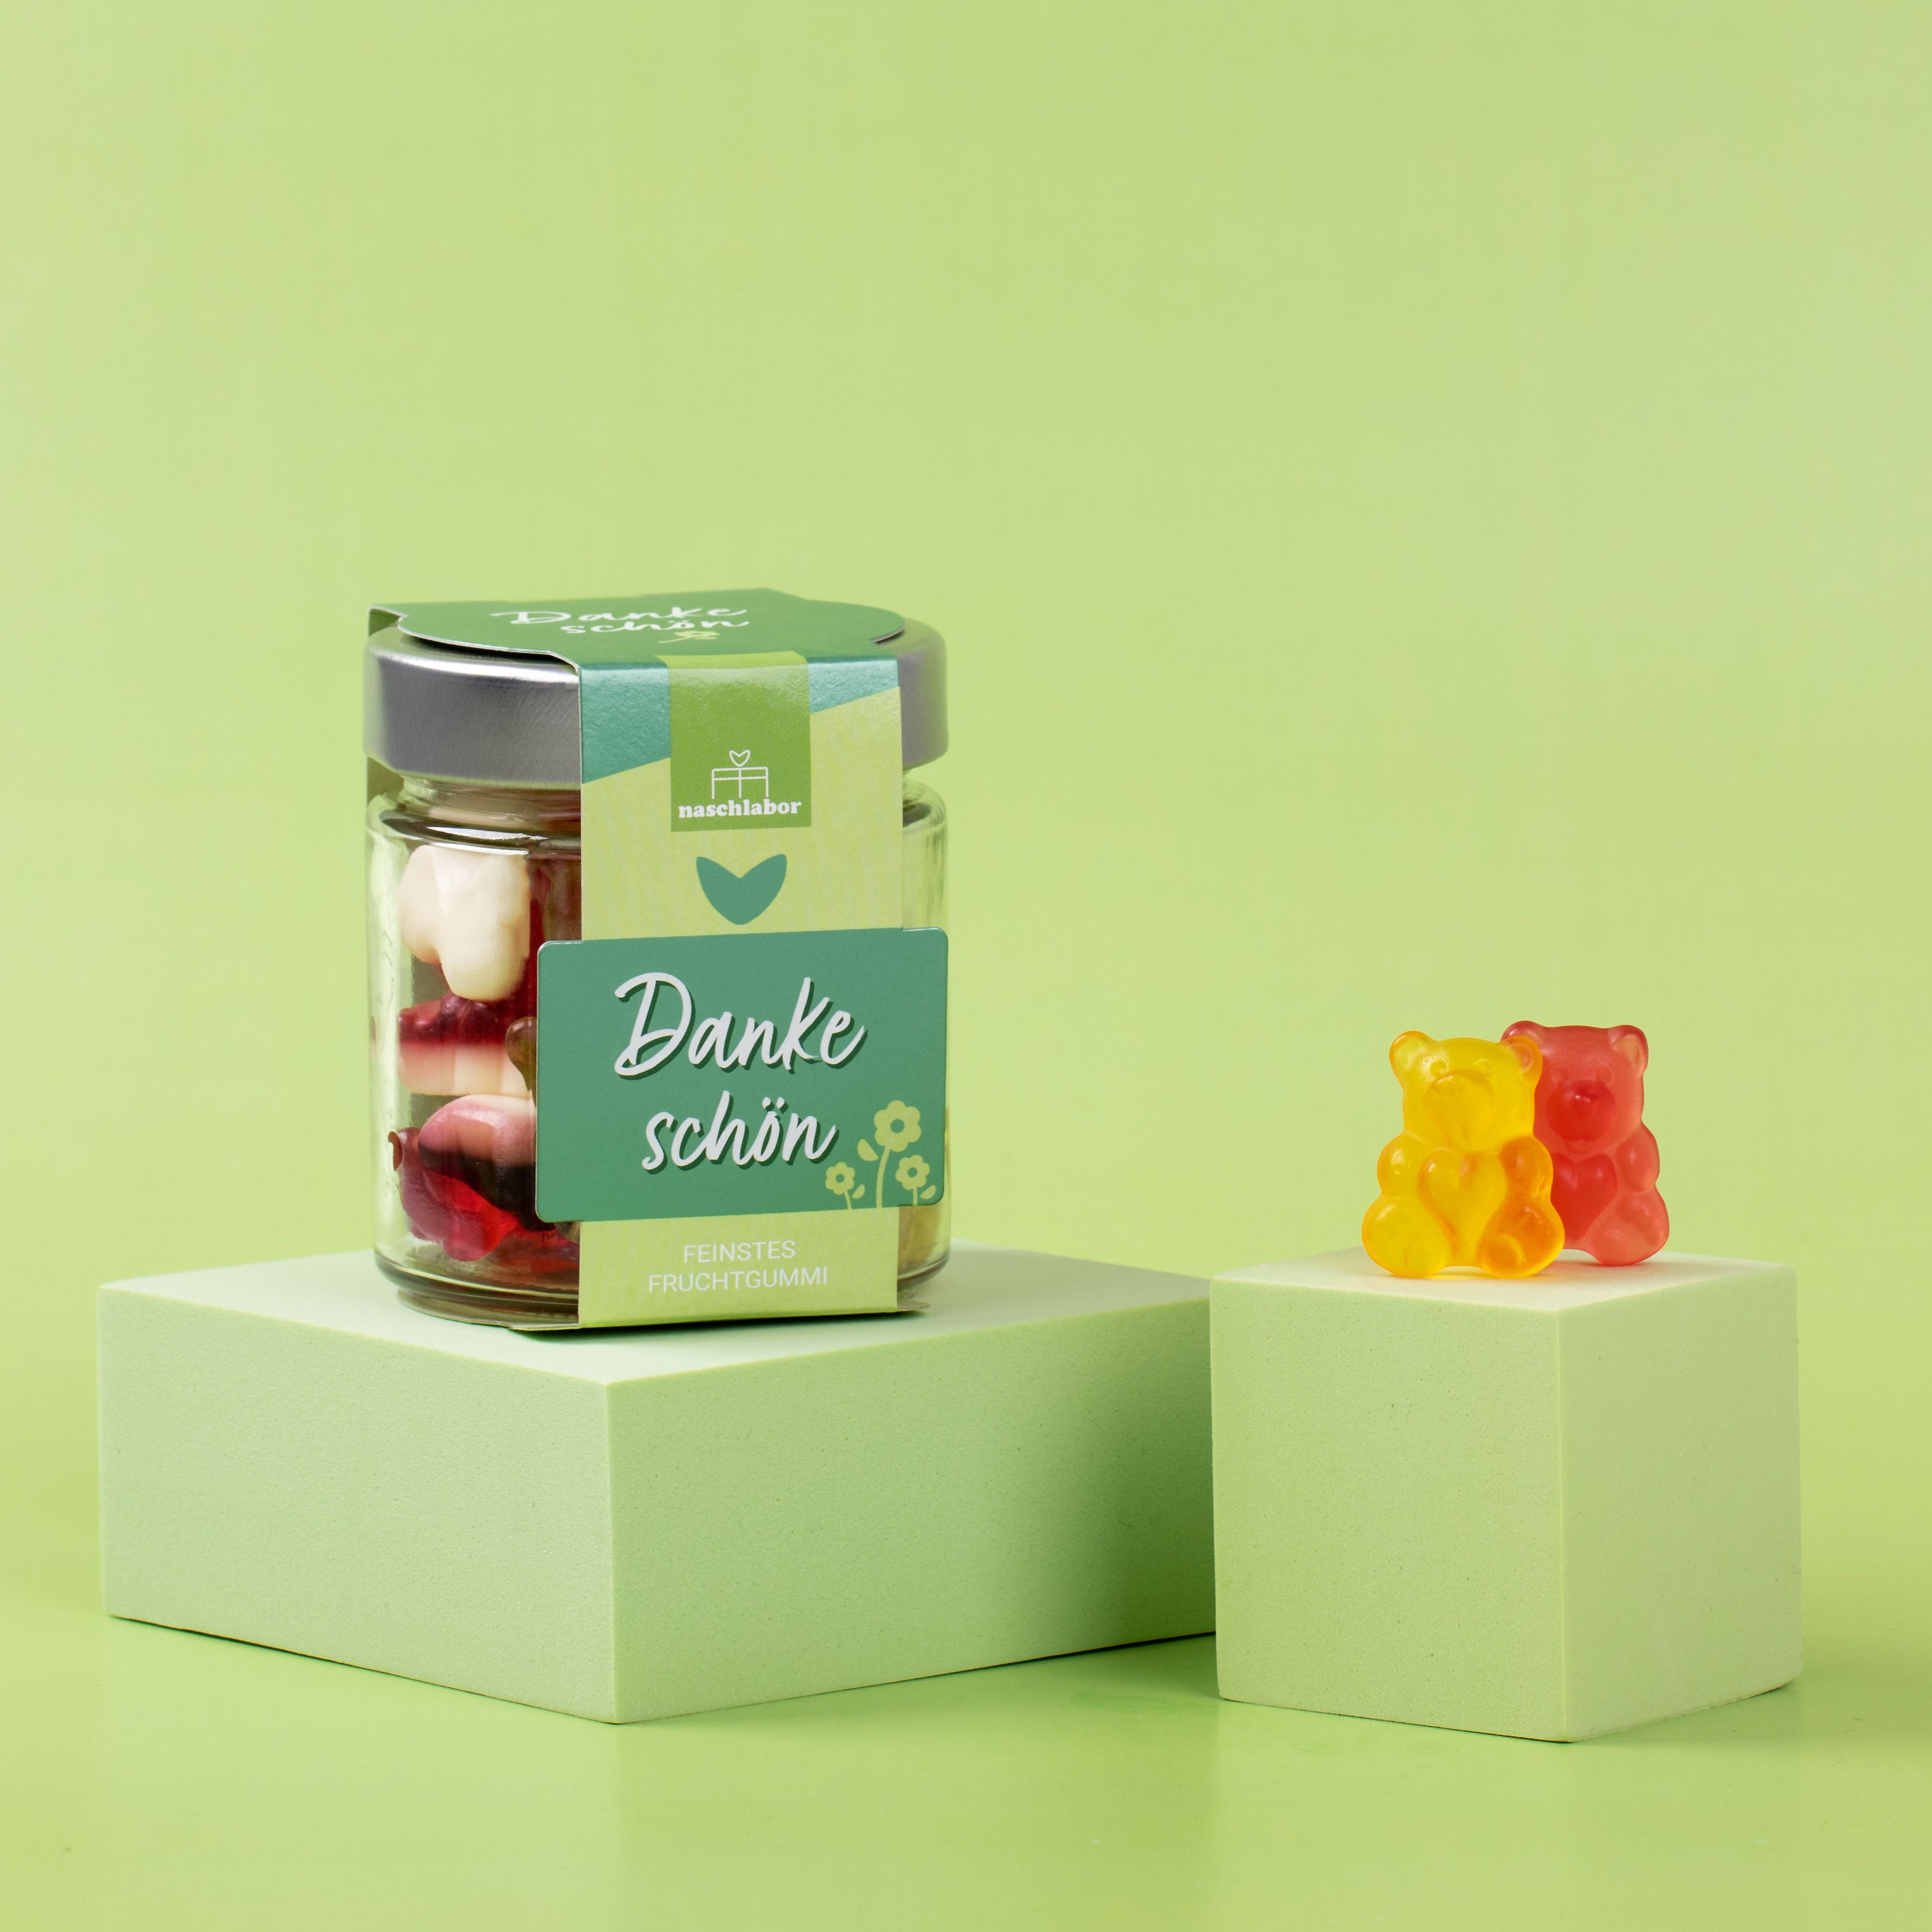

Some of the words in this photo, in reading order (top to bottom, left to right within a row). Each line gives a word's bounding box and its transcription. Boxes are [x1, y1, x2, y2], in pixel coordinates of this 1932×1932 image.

[490, 606, 748, 624] Danke
[560, 620, 750, 634] schön
[678, 798, 802, 819] naschlabor
[614, 972, 865, 1076] Danke
[642, 1090, 837, 1171] schön
[683, 1240, 796, 1264] FEINSTES
[648, 1266, 828, 1293] FRUCHTGUMMI
